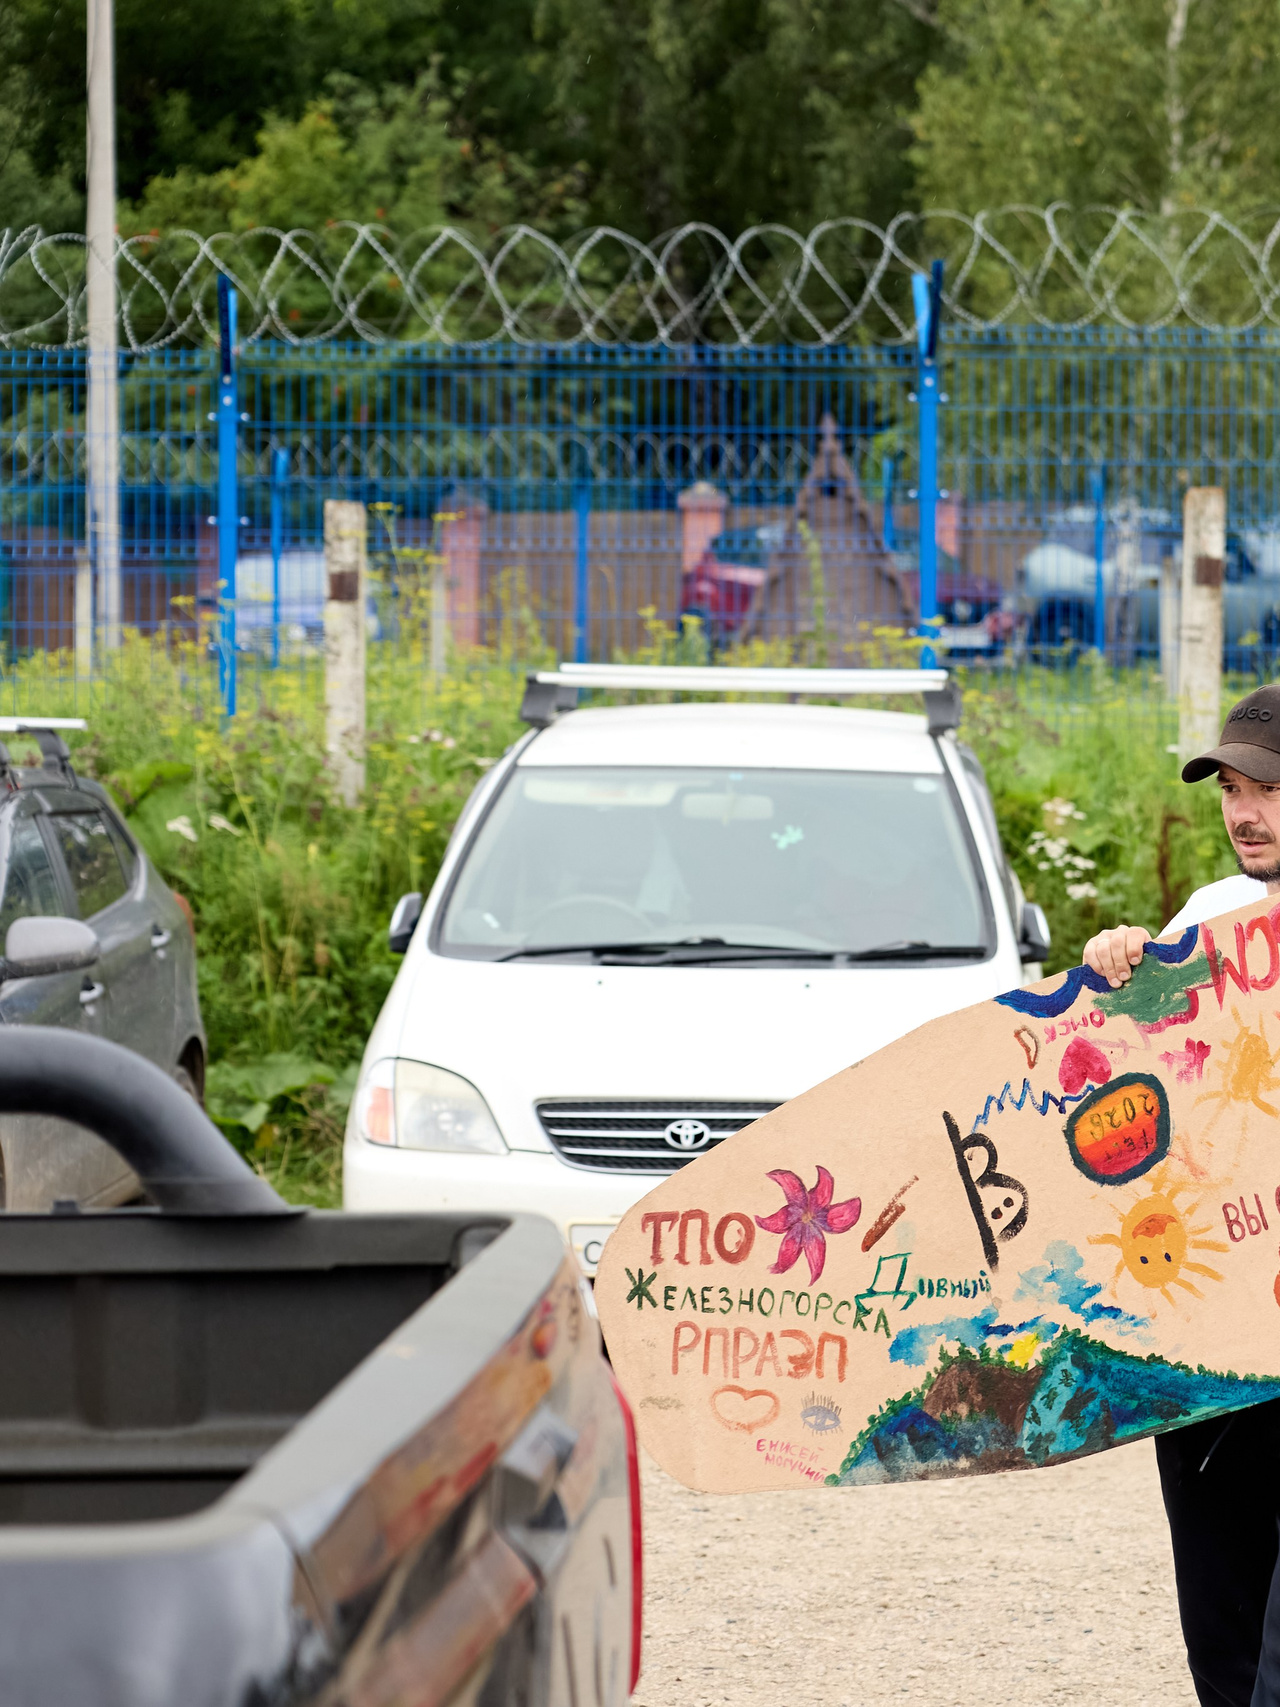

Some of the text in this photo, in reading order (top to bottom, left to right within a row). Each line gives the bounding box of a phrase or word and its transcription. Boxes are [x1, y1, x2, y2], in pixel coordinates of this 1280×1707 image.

[1229, 707, 1273, 723] HUGO
[1089, 1093, 1157, 1141] 2026
[641, 1209, 757, 1266] ТПО
[1222, 1194, 1268, 1245] ВЫ
[756, 1438, 824, 1463] ЕНИСЕЙ
[764, 1452, 828, 1483] МОГУЧИЙ
